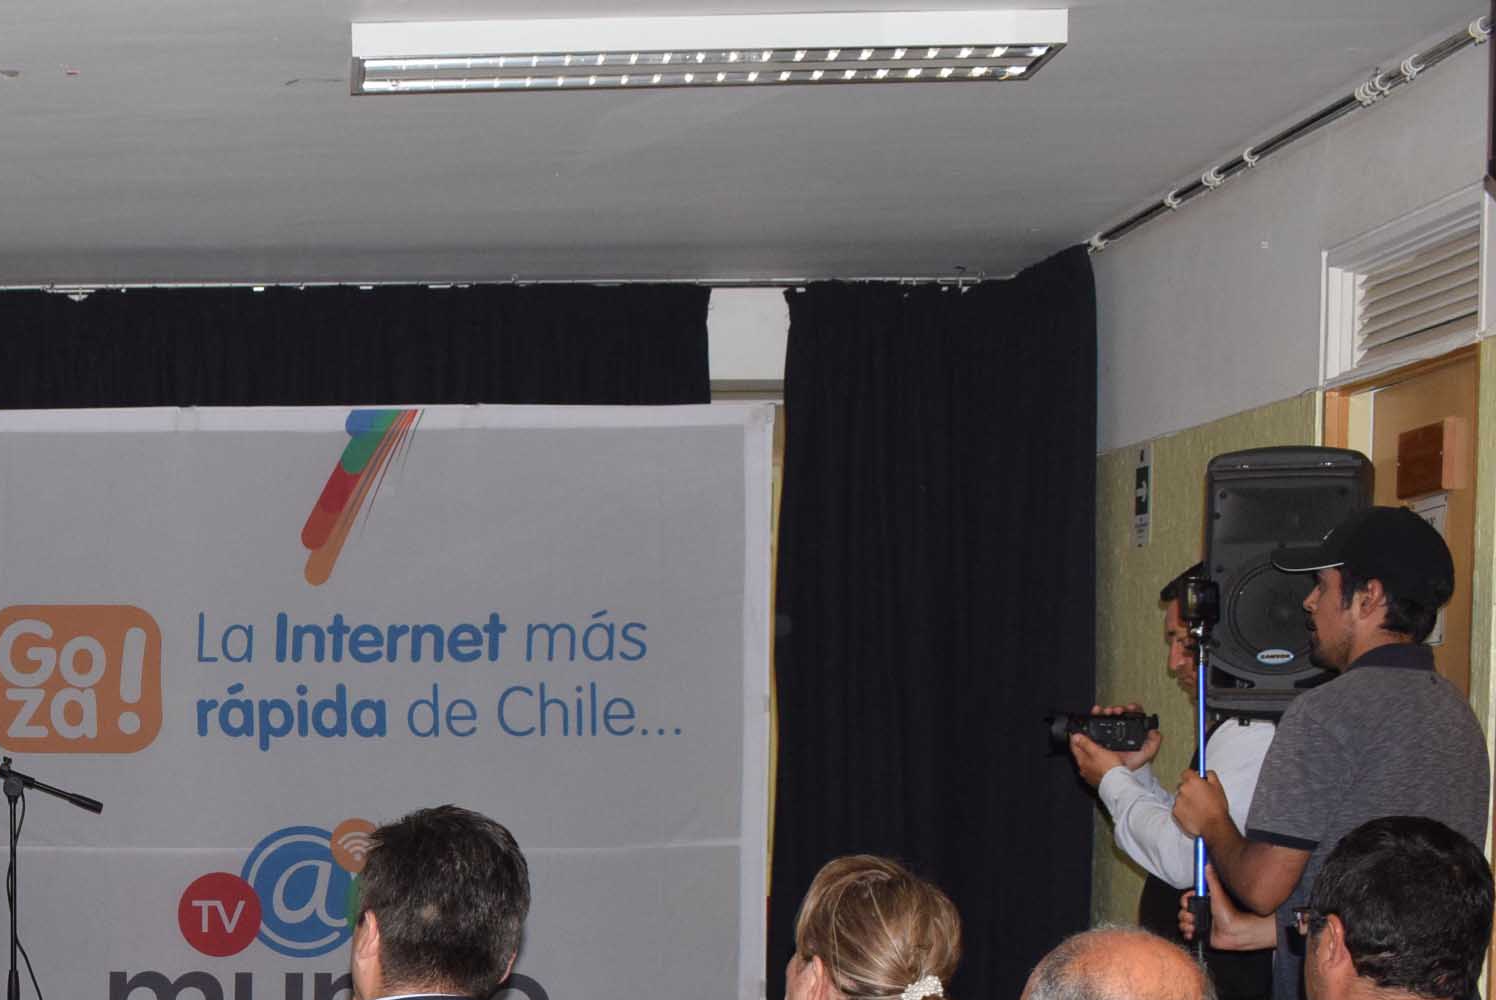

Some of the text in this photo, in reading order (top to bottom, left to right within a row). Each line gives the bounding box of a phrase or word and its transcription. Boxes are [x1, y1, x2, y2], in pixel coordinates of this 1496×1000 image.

[197, 609, 648, 663] La Internet más
[196, 683, 387, 752] rápida
[407, 683, 478, 737] de
[192, 900, 245, 934] TV
